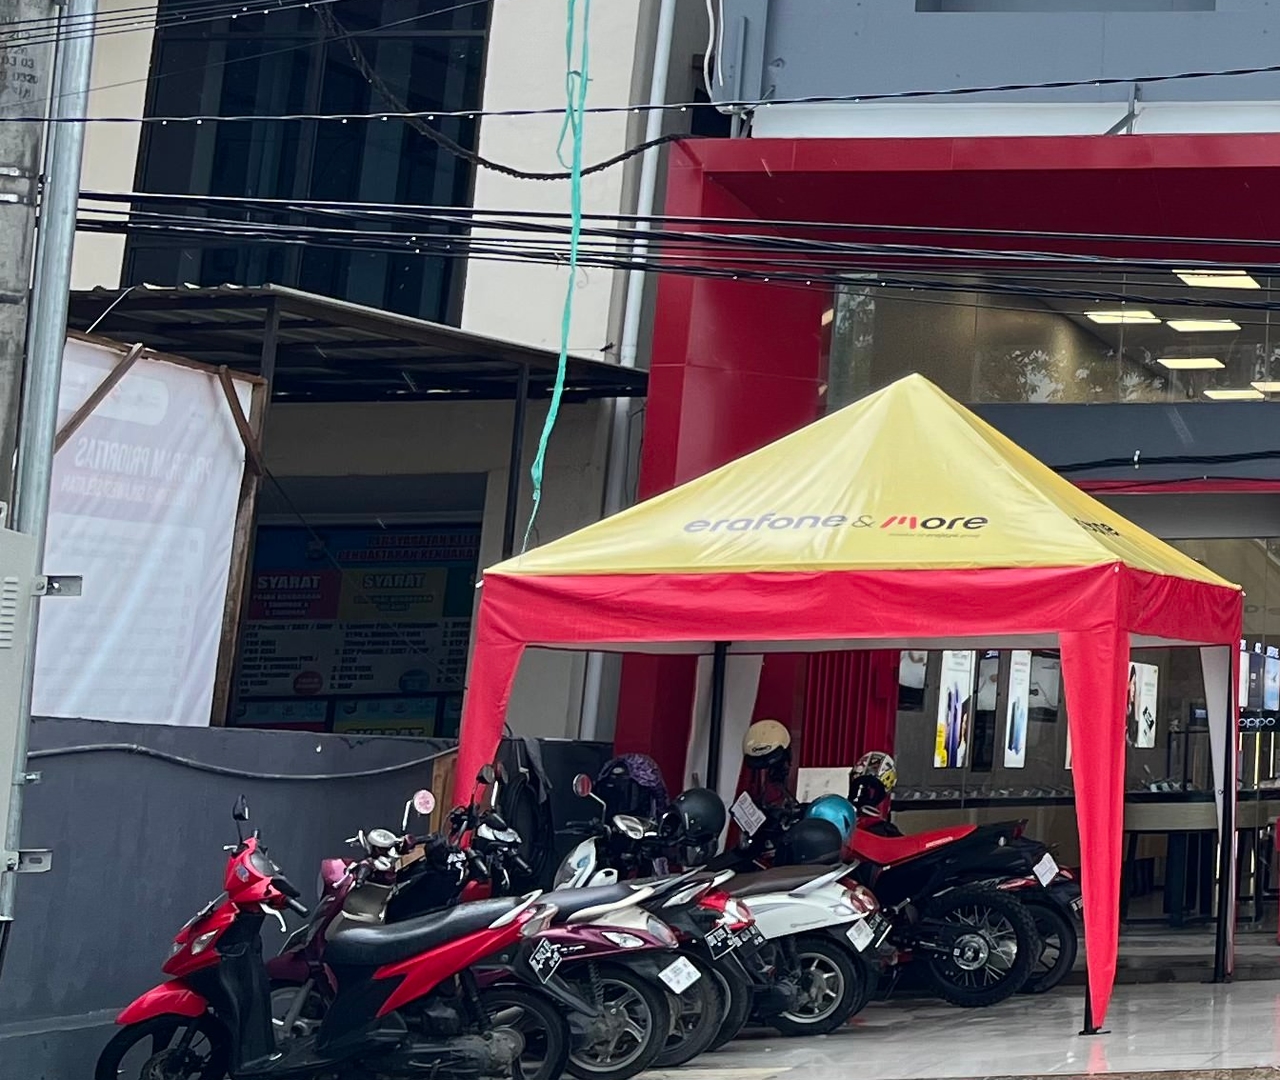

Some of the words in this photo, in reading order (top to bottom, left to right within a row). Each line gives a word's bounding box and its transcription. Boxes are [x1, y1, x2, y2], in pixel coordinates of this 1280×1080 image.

[683, 512, 848, 534] erafone
[851, 514, 877, 528] &
[257, 575, 321, 590] SYARAT
[363, 573, 426, 589] SYARAT
[1238, 717, 1276, 729] oppo
